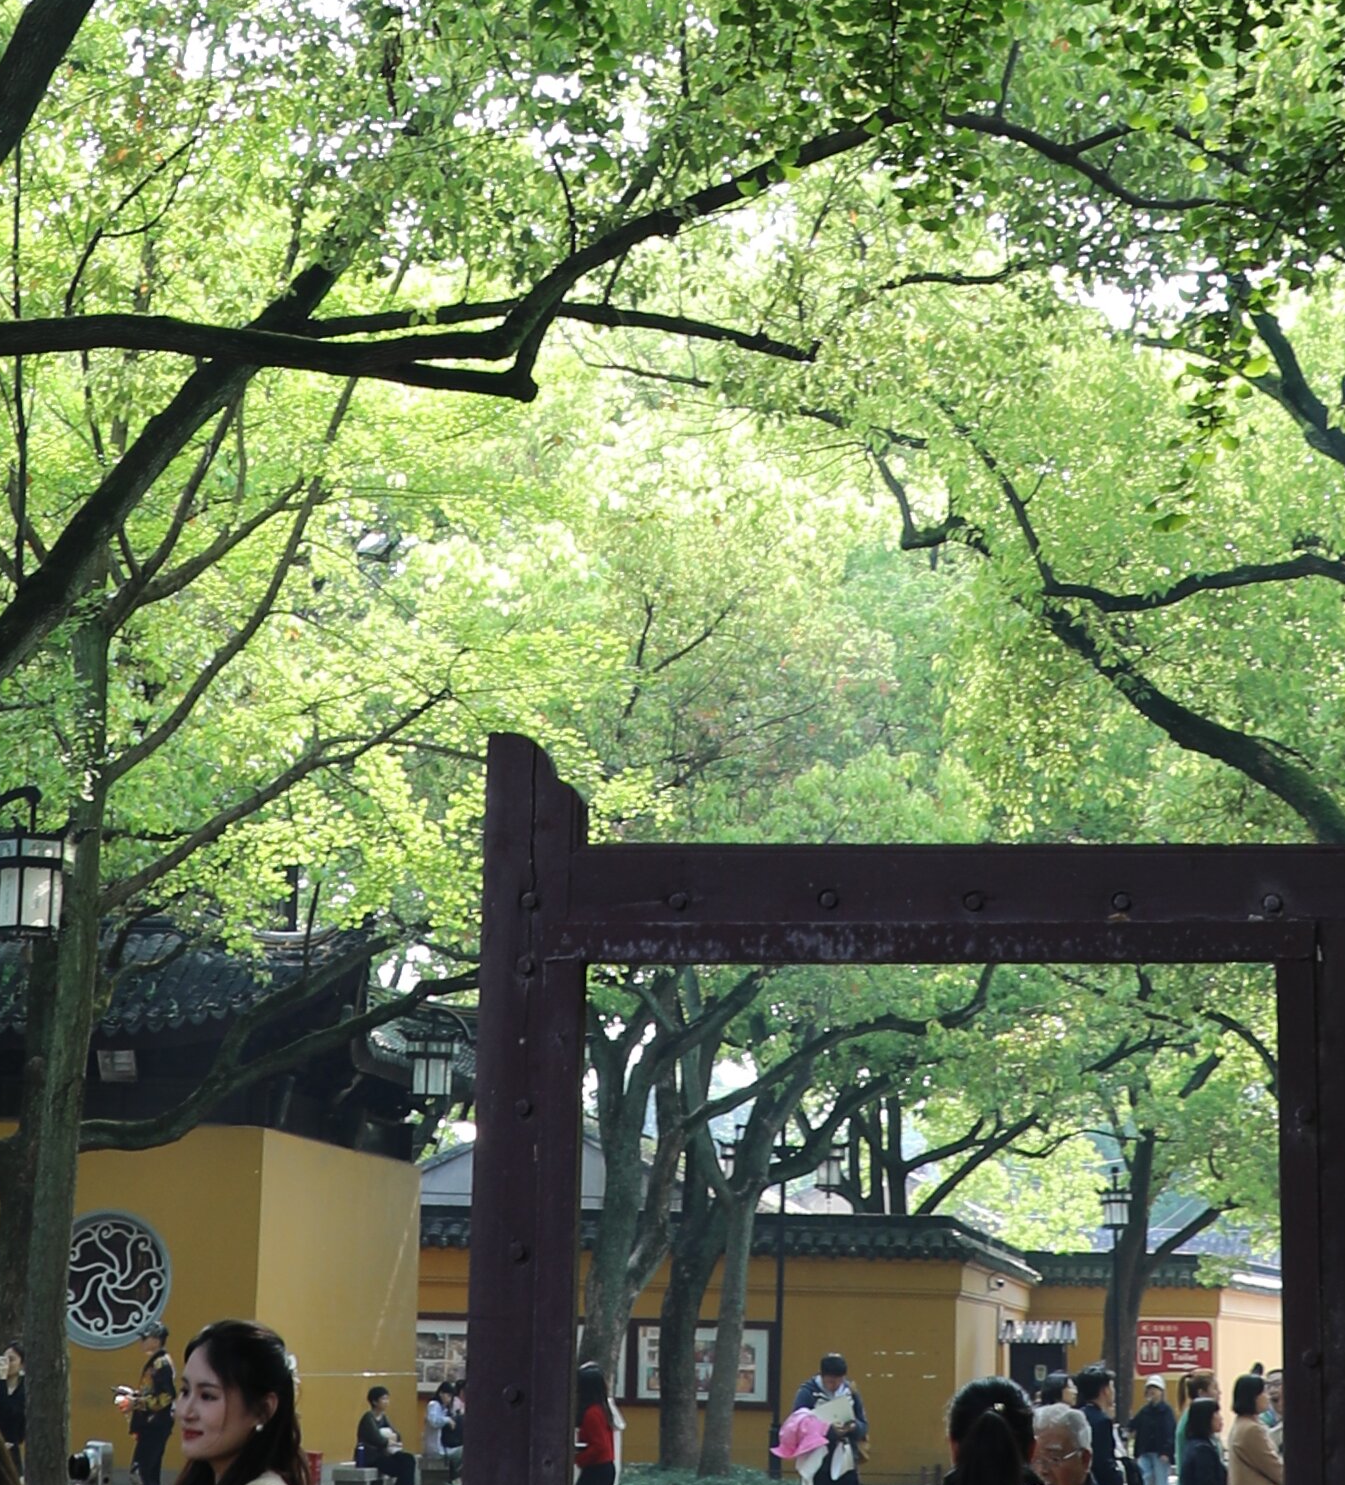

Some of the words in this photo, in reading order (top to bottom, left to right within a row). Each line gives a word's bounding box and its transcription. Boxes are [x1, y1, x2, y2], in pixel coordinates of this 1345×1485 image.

[1163, 1336, 1209, 1351] 卫生间
[1171, 1353, 1198, 1361] Toilet
